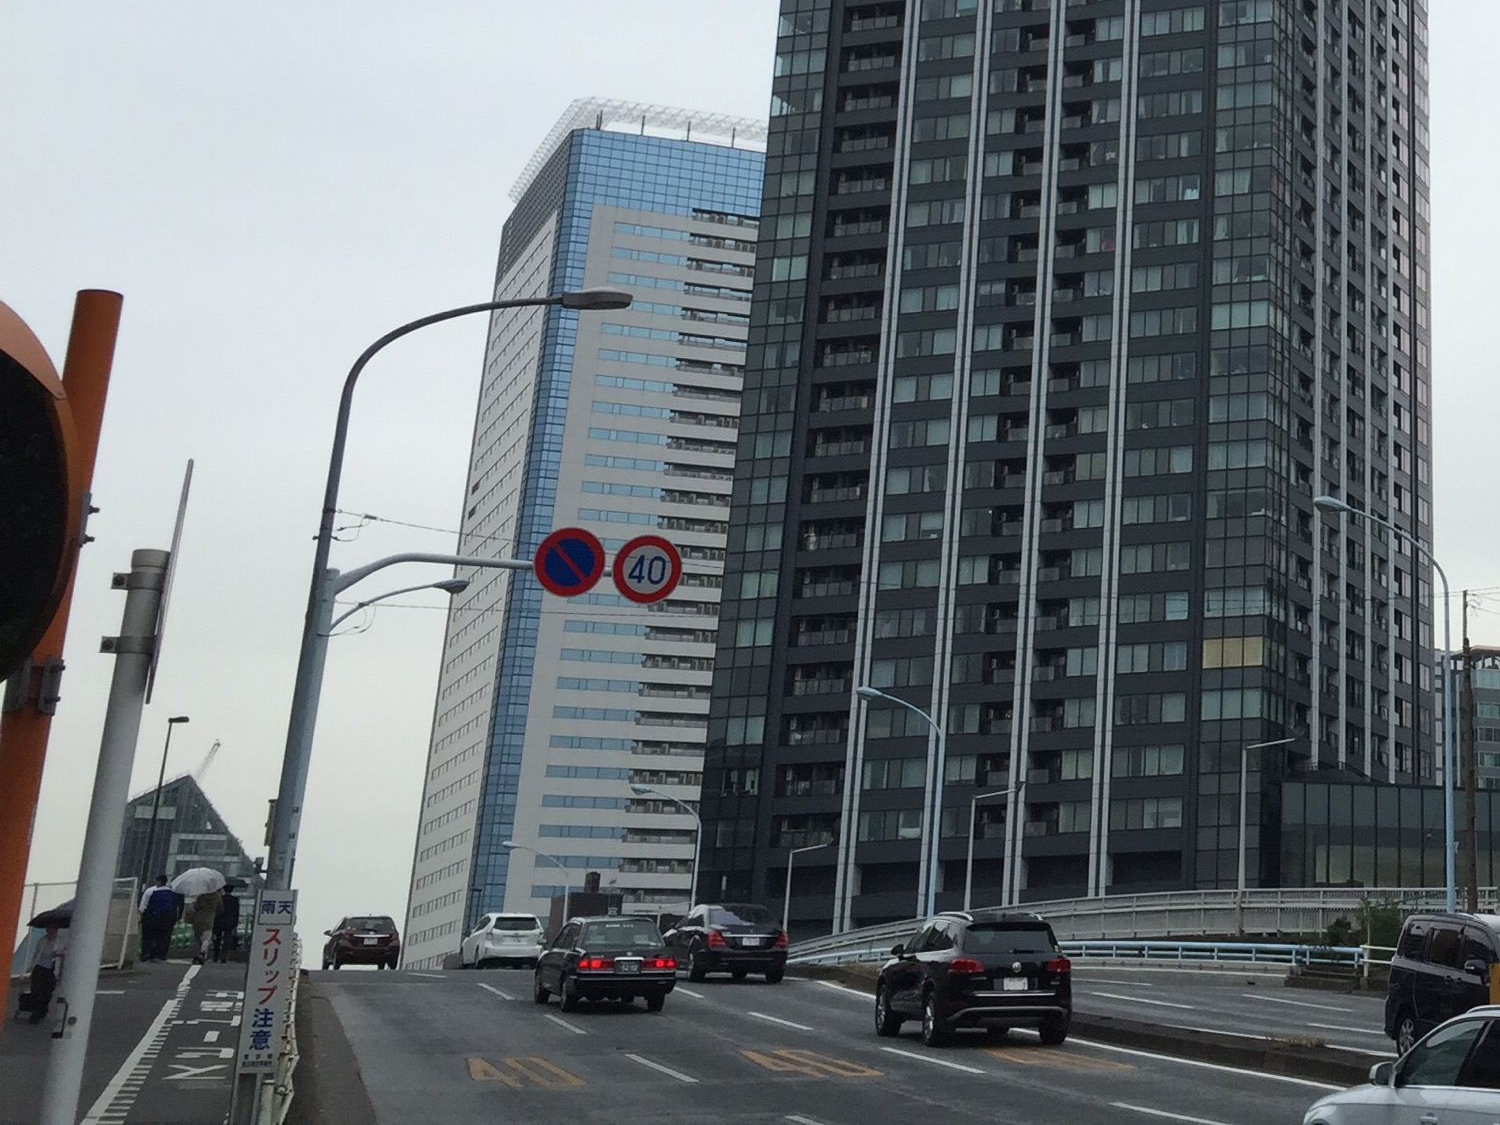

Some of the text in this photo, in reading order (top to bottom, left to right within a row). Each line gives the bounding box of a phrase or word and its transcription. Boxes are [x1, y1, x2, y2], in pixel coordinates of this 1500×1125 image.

[628, 555, 666, 585] 40
[261, 900, 293, 915] 雨天
[249, 928, 282, 1051] スリップ注意
[467, 1056, 587, 1088] 40
[738, 1048, 886, 1078] 40
